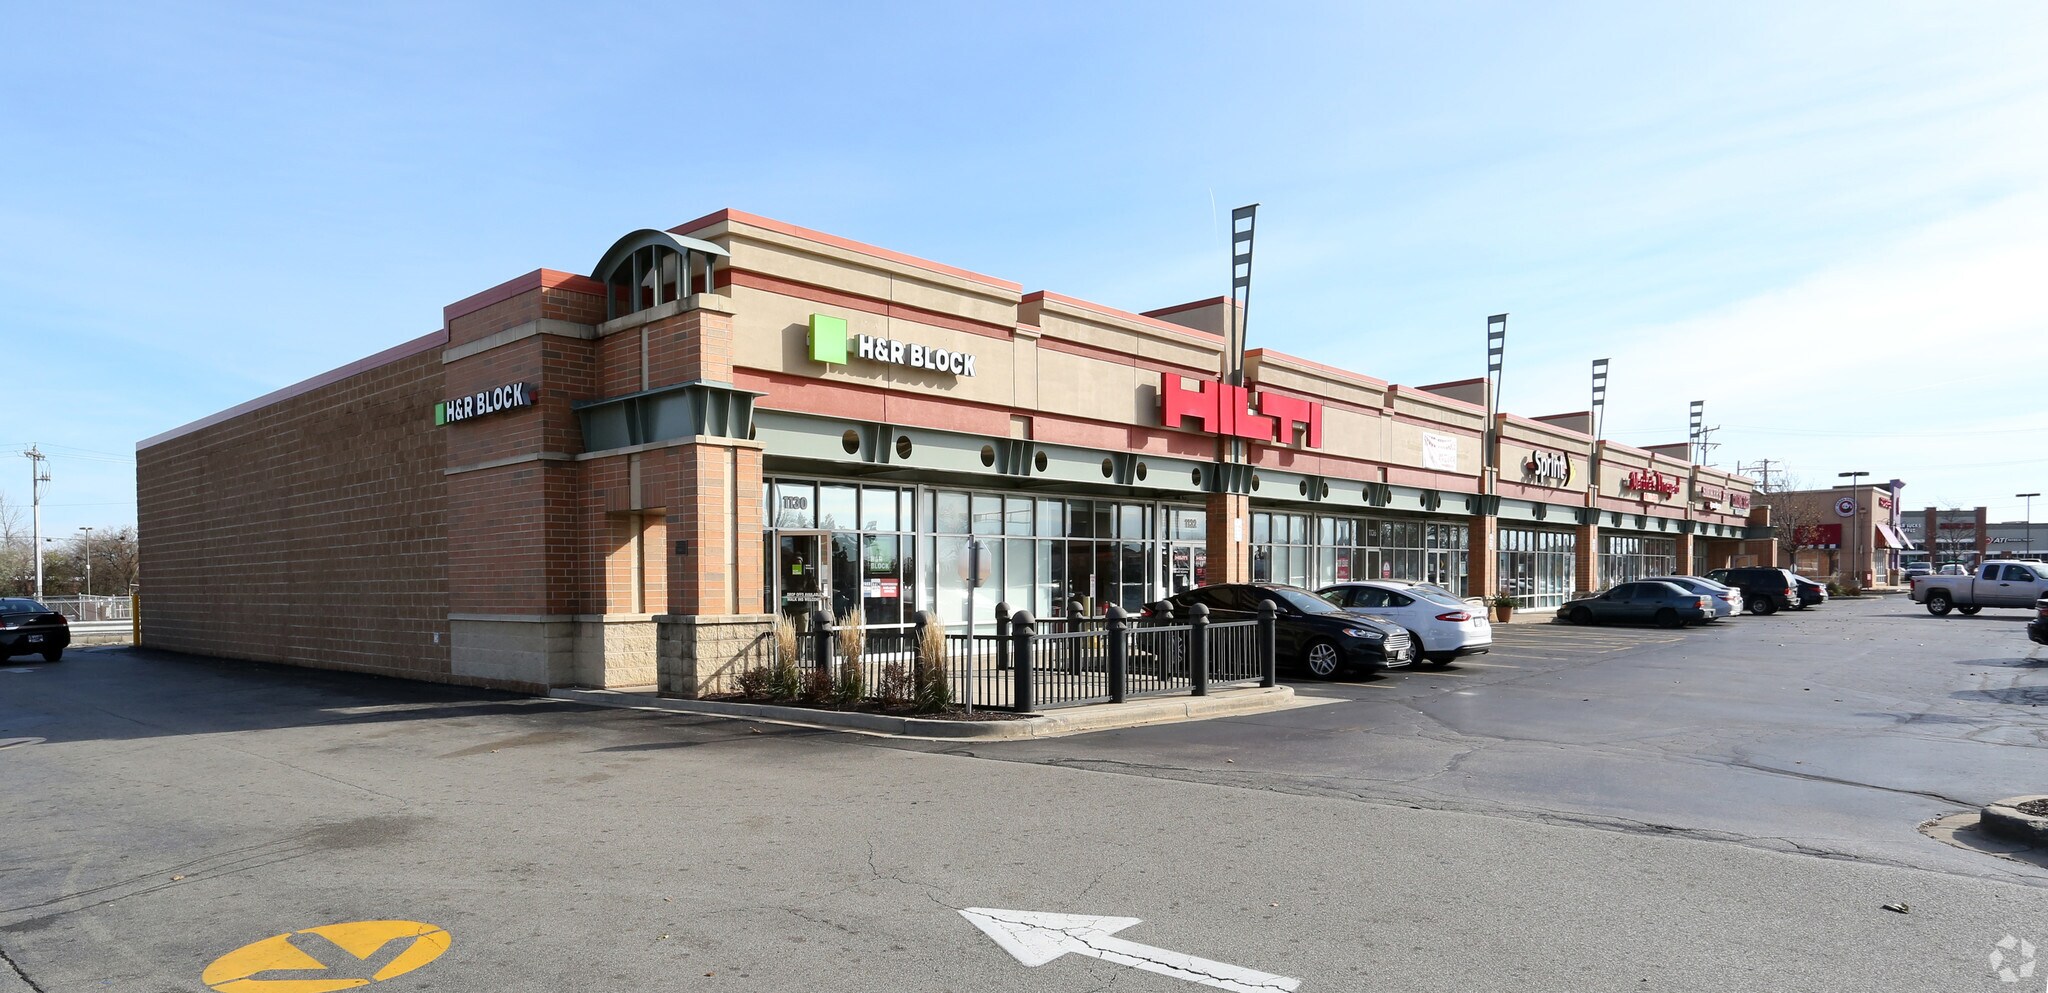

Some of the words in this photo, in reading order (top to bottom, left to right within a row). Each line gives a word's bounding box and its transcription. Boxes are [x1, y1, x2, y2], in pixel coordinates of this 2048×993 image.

[858, 333, 904, 365] H&R
[909, 342, 976, 377] BLOCK
[446, 395, 473, 423] H&R
[476, 382, 523, 415] BLOCK
[1162, 371, 1322, 449] HILTI
[1533, 449, 1566, 483] Sprint
[782, 495, 807, 510] 1130
[870, 562, 890, 570] BLOCK
